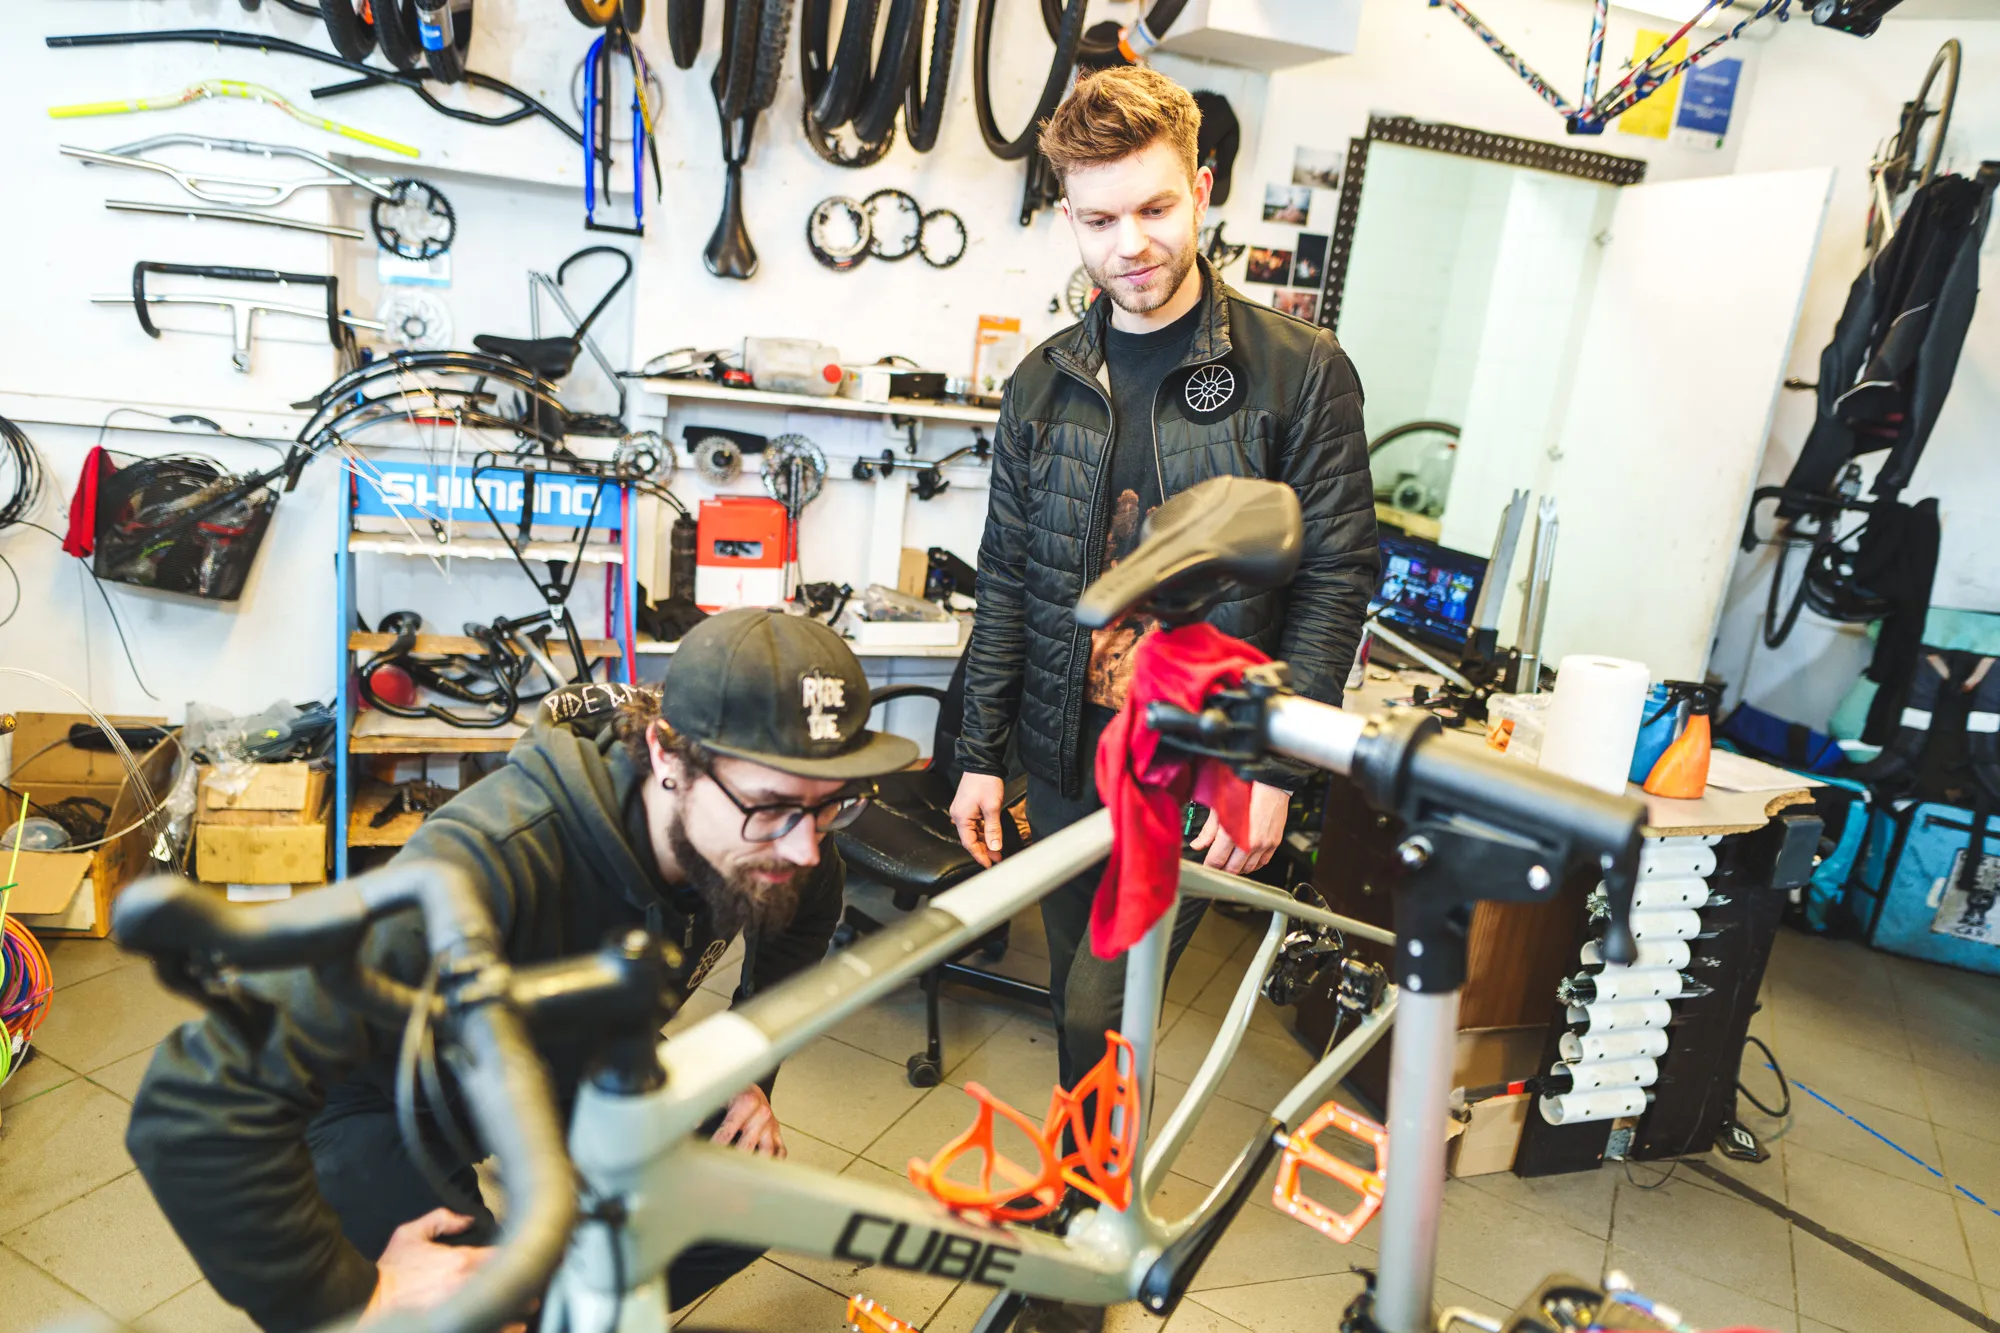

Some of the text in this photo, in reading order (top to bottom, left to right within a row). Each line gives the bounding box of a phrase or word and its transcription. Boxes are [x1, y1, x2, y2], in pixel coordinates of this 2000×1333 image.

[381, 472, 602, 517] SHIMANO
[543, 685, 600, 722] RIDE
[802, 672, 846, 708] RIDE
[833, 1210, 1021, 1288] CUBE
